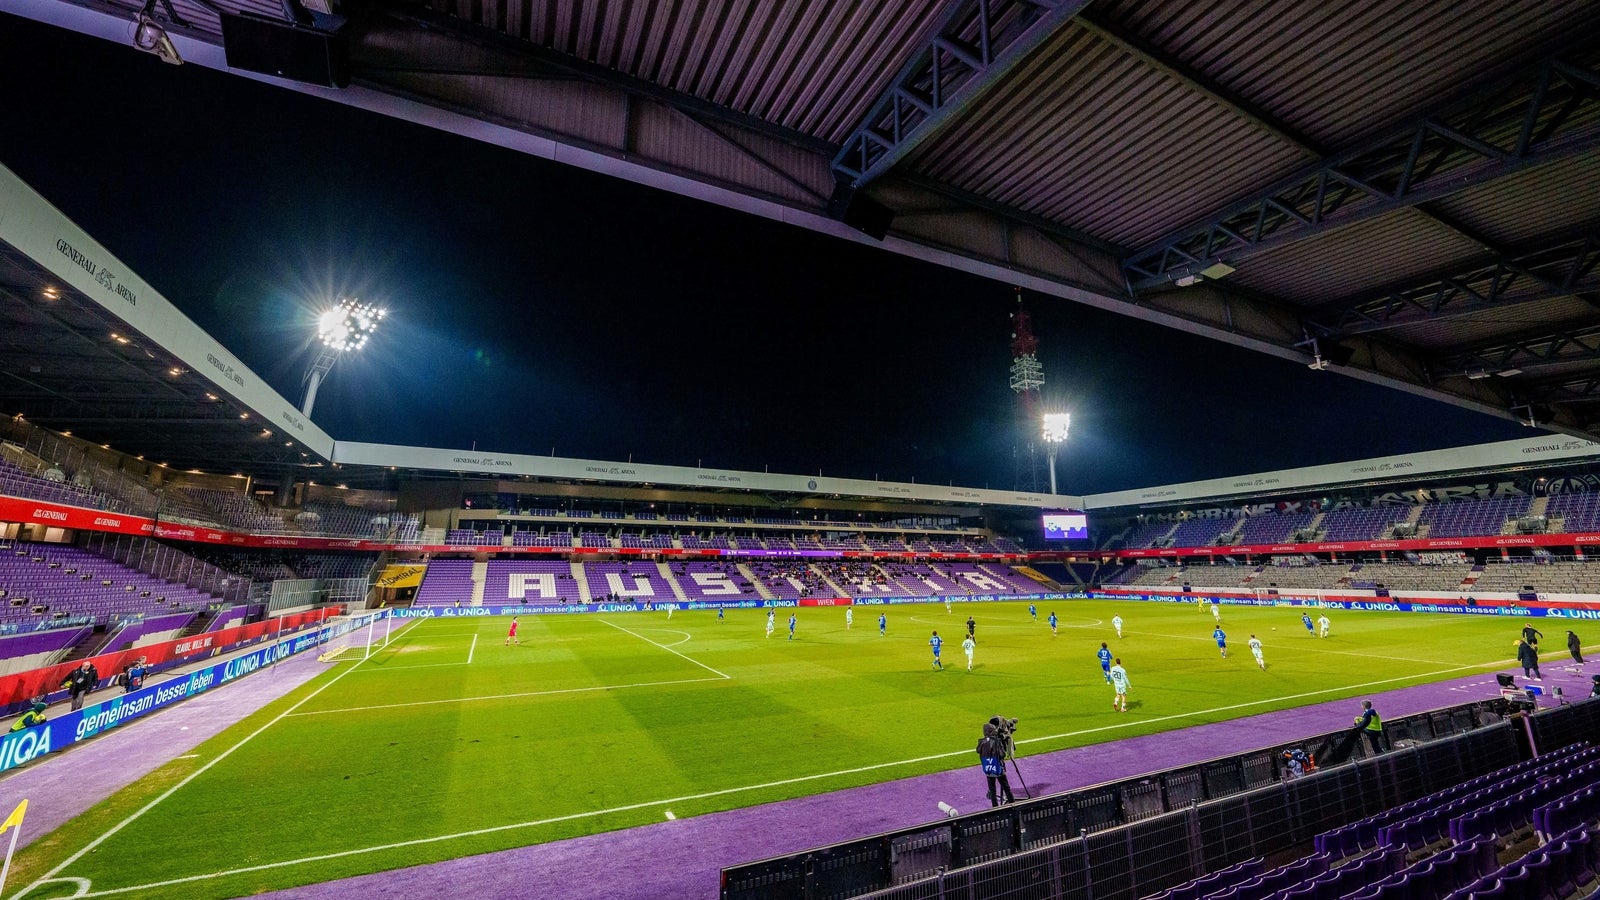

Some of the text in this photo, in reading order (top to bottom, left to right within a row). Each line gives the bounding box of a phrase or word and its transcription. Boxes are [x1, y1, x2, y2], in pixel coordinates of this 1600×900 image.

[56, 239, 136, 306] GENERALI ARENA
[1522, 444, 1560, 454] GENERALI
[453, 457, 480, 465] GENERALI
[1394, 461, 1413, 469] ARENA
[42, 510, 68, 521] GENERALI
[101, 518, 120, 528] GENERALI
[381, 567, 422, 586] ADMIRAL
[501, 605, 543, 614] gemeinsam
[545, 604, 568, 612] besser
[688, 602, 721, 610] gemeinsam
[1366, 603, 1400, 611] UNIQA
[1411, 604, 1530, 615] gemeinsam besser leben
[401, 609, 435, 618] UNIQA
[458, 608, 490, 616] UNIQA
[236, 655, 260, 677] UNIQA
[75, 672, 214, 741] gemeinsam besser leben
